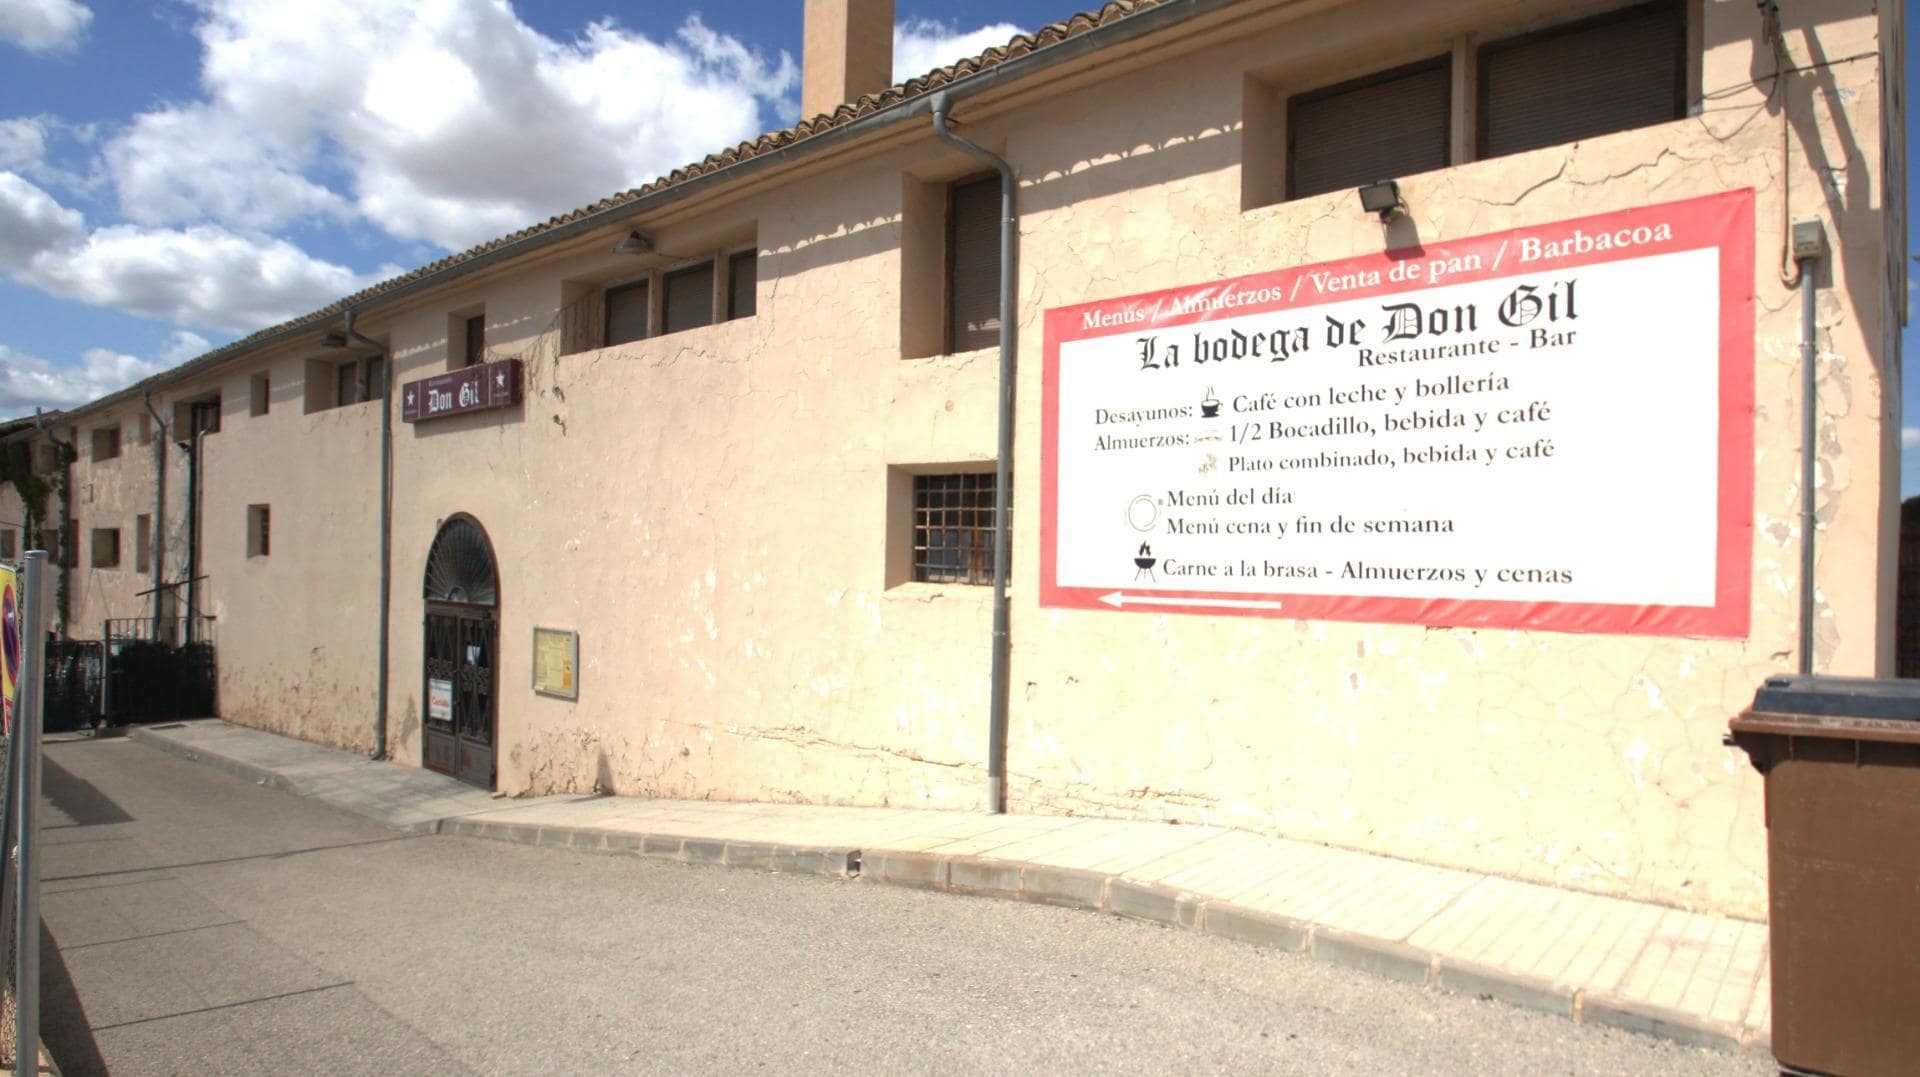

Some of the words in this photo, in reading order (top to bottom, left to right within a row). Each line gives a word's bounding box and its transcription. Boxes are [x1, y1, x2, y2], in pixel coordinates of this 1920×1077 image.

[1082, 302, 1145, 330] Menús
[1170, 287, 1282, 316] Almuerzos
[1309, 268, 1380, 293] Venta
[1389, 260, 1421, 283] de
[1429, 254, 1481, 284] pan
[1520, 222, 1673, 263] Barbacoa
[1136, 335, 1179, 370] La
[1194, 323, 1309, 364] bodega
[1325, 315, 1366, 349] de
[1381, 302, 1478, 344] Don
[1498, 278, 1580, 327] Gil
[1358, 340, 1500, 367] Restaurante
[1529, 328, 1577, 349] Bar
[428, 389, 452, 414] Don
[459, 380, 480, 407] Gil
[1095, 405, 1193, 426] Desayunos:
[1233, 393, 1277, 413] Café
[1284, 394, 1321, 409] con
[1329, 384, 1387, 405] leche
[1394, 386, 1406, 405] y
[1416, 372, 1510, 398] bollería
[1094, 433, 1190, 451] Almuerzos:
[1230, 423, 1262, 445] 1/2
[1269, 415, 1376, 439] Bocadillo,
[1385, 408, 1466, 432] bebida
[1474, 411, 1488, 432] y
[1497, 401, 1551, 424] café
[1229, 456, 1273, 472] Plato
[1279, 449, 1396, 470] combinado,
[1403, 444, 1477, 464] bebida
[1485, 447, 1498, 466] y
[1506, 438, 1555, 459] café
[1167, 488, 1219, 506] Menú
[1226, 488, 1255, 505] del
[1261, 487, 1293, 504] día
[1166, 517, 1219, 535] Menú
[1226, 521, 1271, 535] cena
[1278, 521, 1289, 539] y
[1295, 516, 1322, 534] fin
[1330, 515, 1356, 533] de
[1363, 518, 1454, 534] semana
[1163, 558, 1217, 576] Carne
[1224, 563, 1234, 577] a
[1241, 560, 1256, 577] la
[1264, 560, 1318, 578] brasa
[1341, 561, 1466, 582] Almuerzos
[1474, 567, 1488, 588] y
[1497, 566, 1573, 583] cenas
